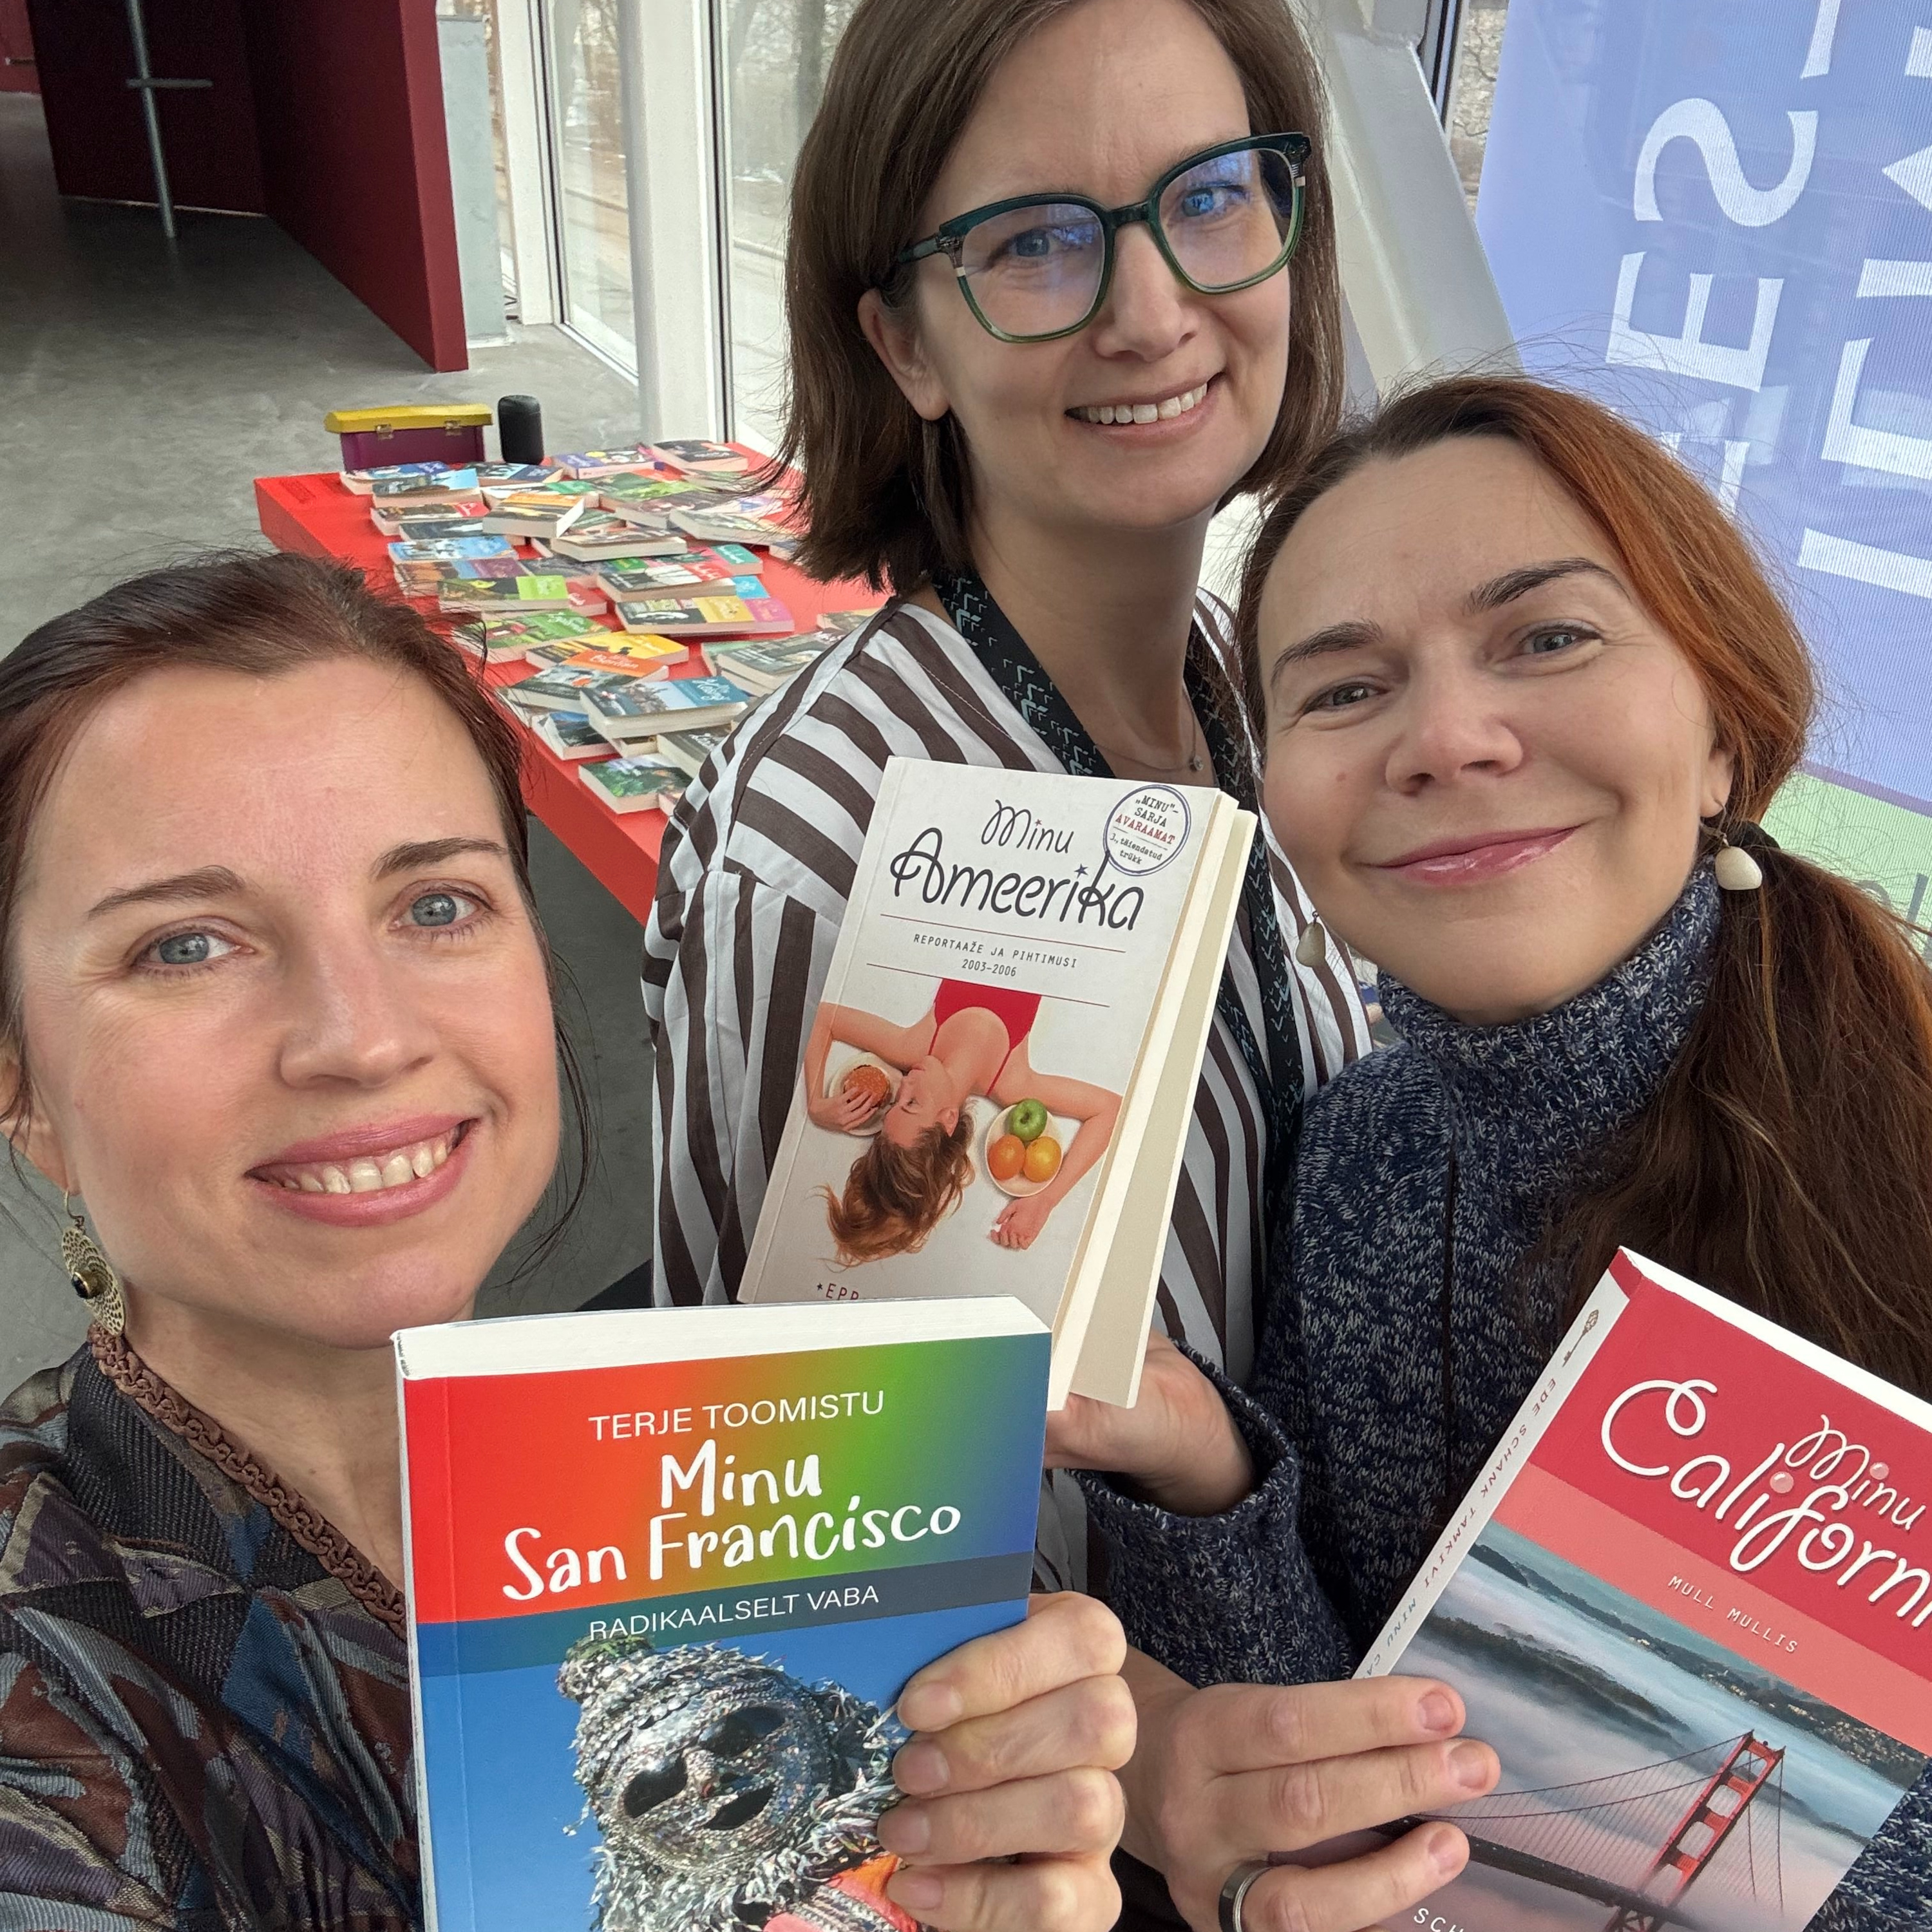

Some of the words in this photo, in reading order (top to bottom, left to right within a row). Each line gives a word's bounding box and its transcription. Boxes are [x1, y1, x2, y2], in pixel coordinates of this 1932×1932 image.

[981, 799, 1074, 854] Minu
[1115, 814, 1176, 844] AVARAAMAT
[1135, 808, 1167, 827] SARJA
[1120, 849, 1142, 864] trükk
[1121, 838, 1162, 860] täiendatud
[890, 828, 1144, 931] Ameerika
[913, 934, 985, 954] REPORTAAŽE
[990, 947, 1005, 958] JA
[1012, 950, 1077, 968] PIHTIMUSI
[588, 1407, 692, 1441] TERJE
[702, 1390, 884, 1430] TOOMISTU
[1532, 1378, 1557, 1416] EDE
[661, 1439, 822, 1517] Minu
[1481, 1424, 1527, 1499] SCHANK
[1785, 1414, 1926, 1530] Minu
[503, 1527, 627, 1600] San
[649, 1495, 961, 1580] Francisco
[1425, 1507, 1476, 1589] TAMKIVI
[590, 1595, 799, 1642] RADIKAALSELT
[805, 1585, 879, 1610] VABA
[1387, 1598, 1417, 1647] MINU
[1668, 1575, 1714, 1610] MULL
[1727, 1608, 1799, 1654] MULLIS
